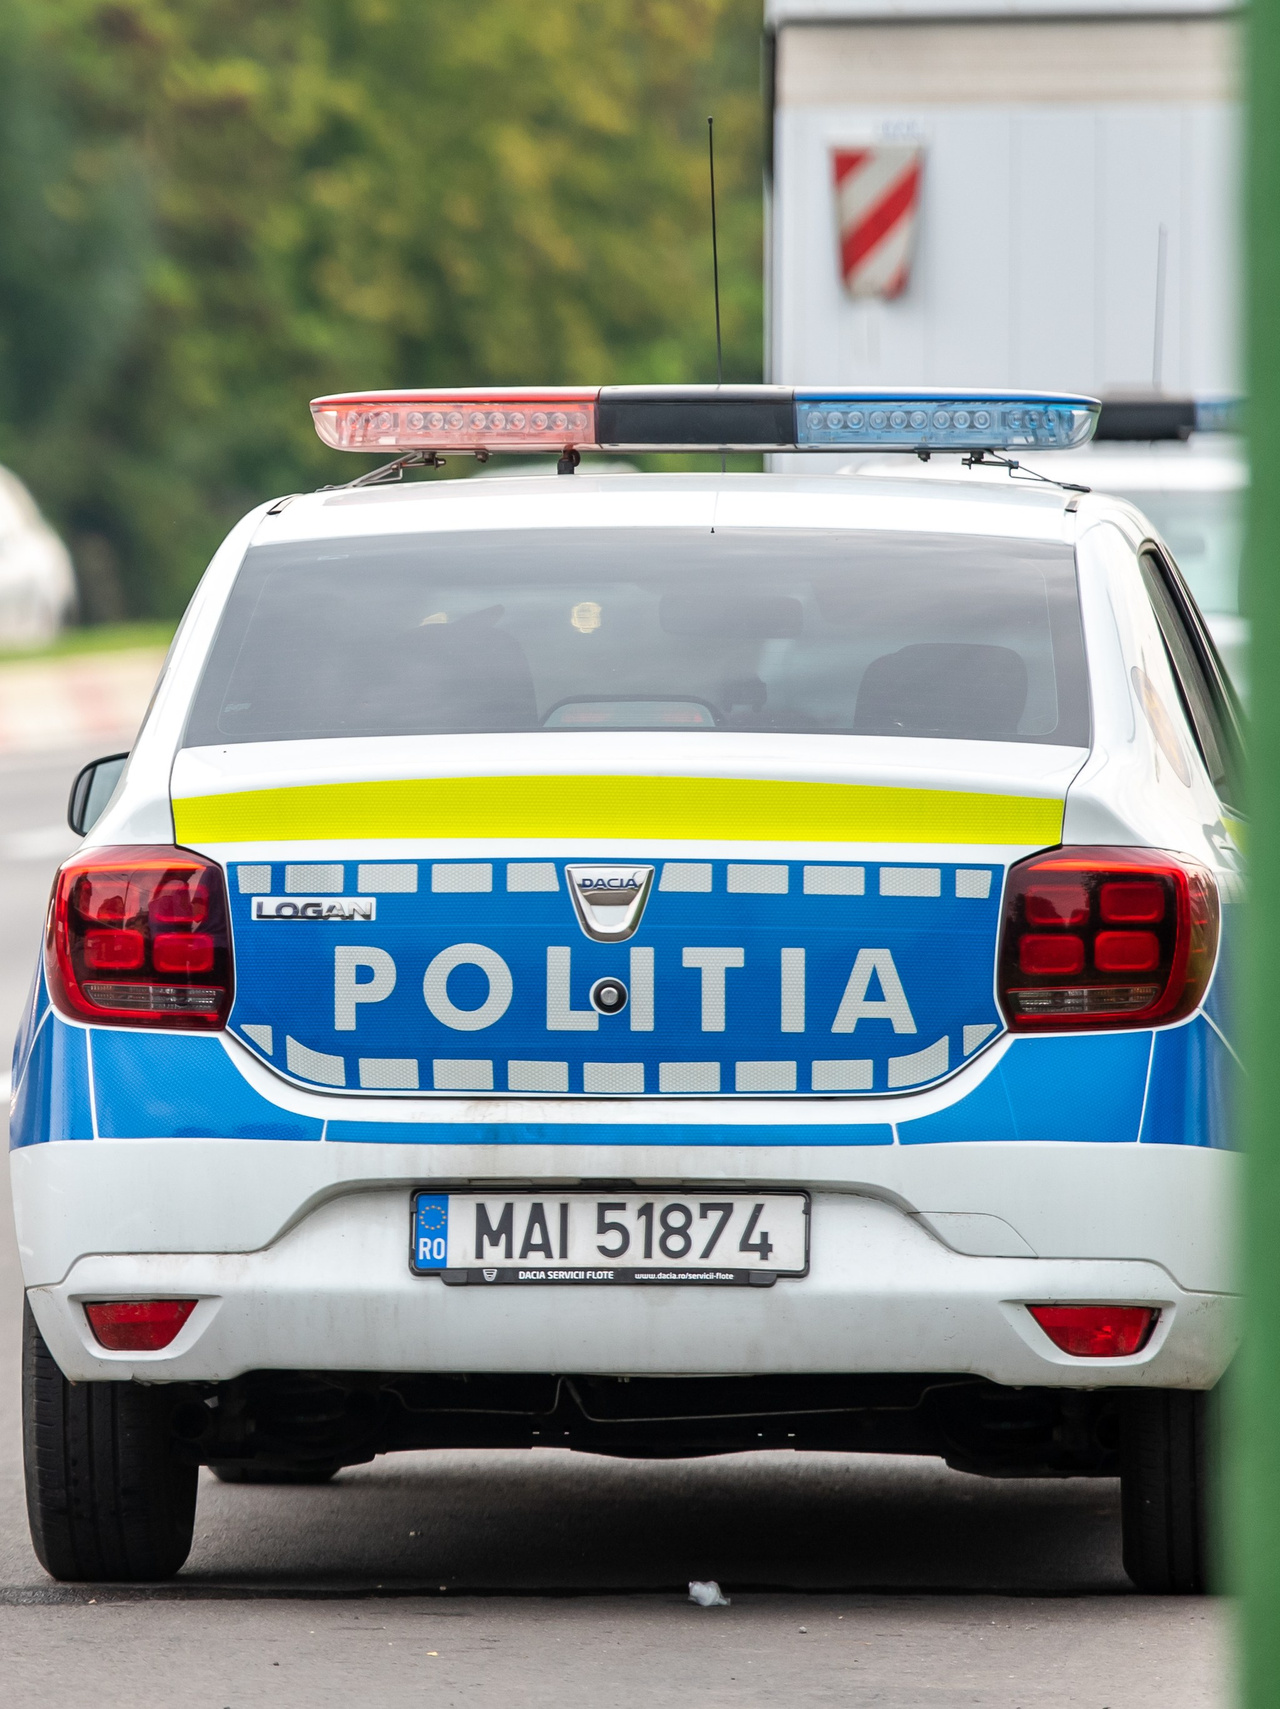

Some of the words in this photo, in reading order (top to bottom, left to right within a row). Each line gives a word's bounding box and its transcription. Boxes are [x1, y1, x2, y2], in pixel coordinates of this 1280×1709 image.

[581, 878, 638, 888] DACIA
[256, 901, 372, 920] LOGAN
[334, 943, 917, 1034] POLITIA
[474, 1202, 569, 1260] MAI
[596, 1202, 774, 1261] 51874
[419, 1238, 446, 1260] RO
[518, 1271, 546, 1280] DACIA
[547, 1271, 585, 1280] SERVICII
[586, 1271, 614, 1280] FLOTE
[634, 1272, 734, 1280] www.dacia.ro/servicii-flote
